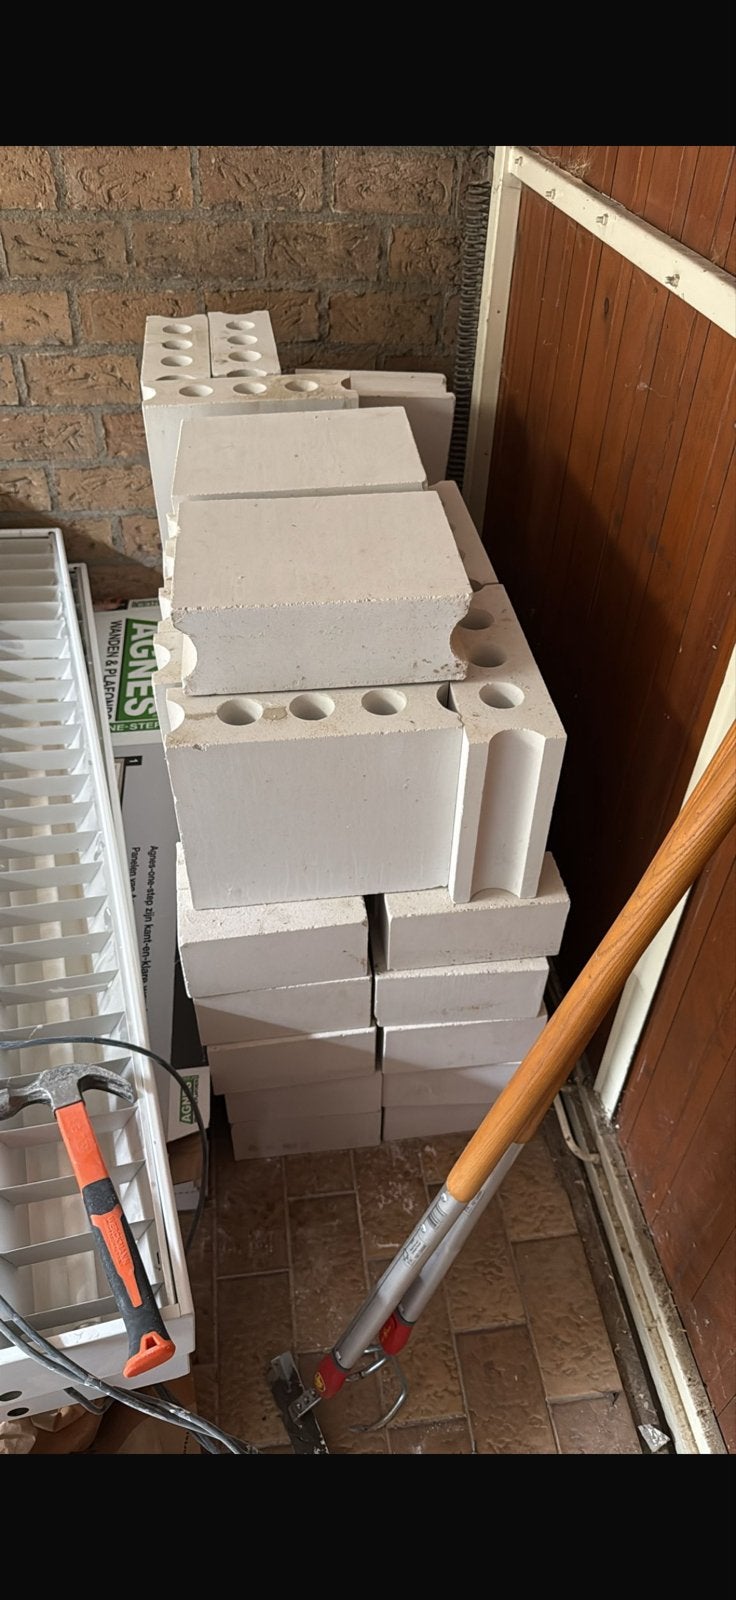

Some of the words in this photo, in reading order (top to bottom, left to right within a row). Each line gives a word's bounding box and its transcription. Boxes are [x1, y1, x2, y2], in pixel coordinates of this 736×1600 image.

[106, 620, 122, 657] WANDEN
[123, 622, 158, 717] AGNES
[129, 847, 141, 877] Panelen
[144, 845, 159, 906] Agnes-one-step
[143, 907, 155, 922] zijn
[181, 1082, 192, 1122] AGNS
